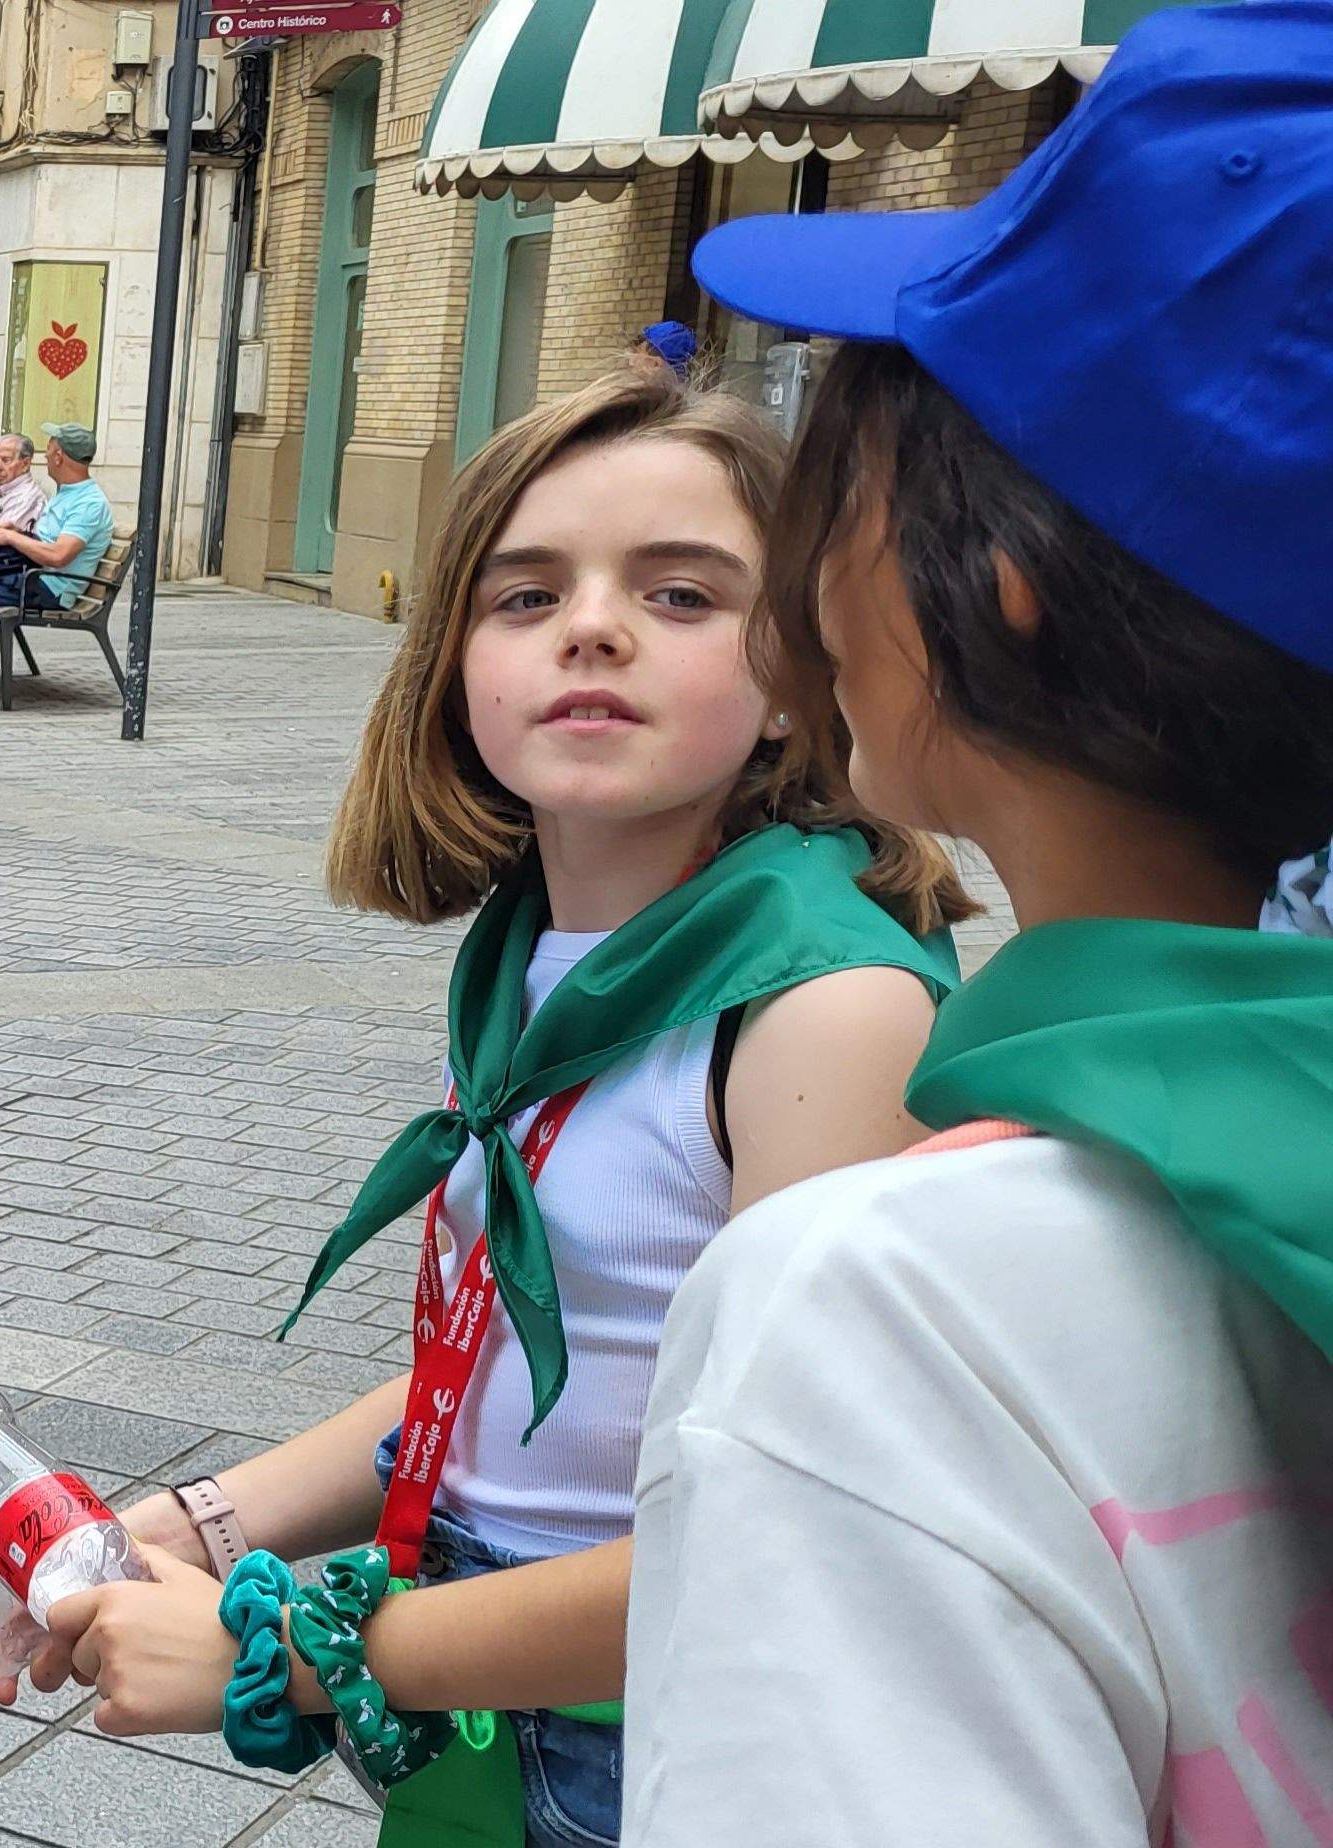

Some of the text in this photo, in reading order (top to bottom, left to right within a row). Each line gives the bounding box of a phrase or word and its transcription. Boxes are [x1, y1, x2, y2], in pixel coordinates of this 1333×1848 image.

[238, 15, 327, 30] Centro Histórico
[442, 1286, 471, 1347] Fundación
[398, 1420, 425, 1481] Fundación
